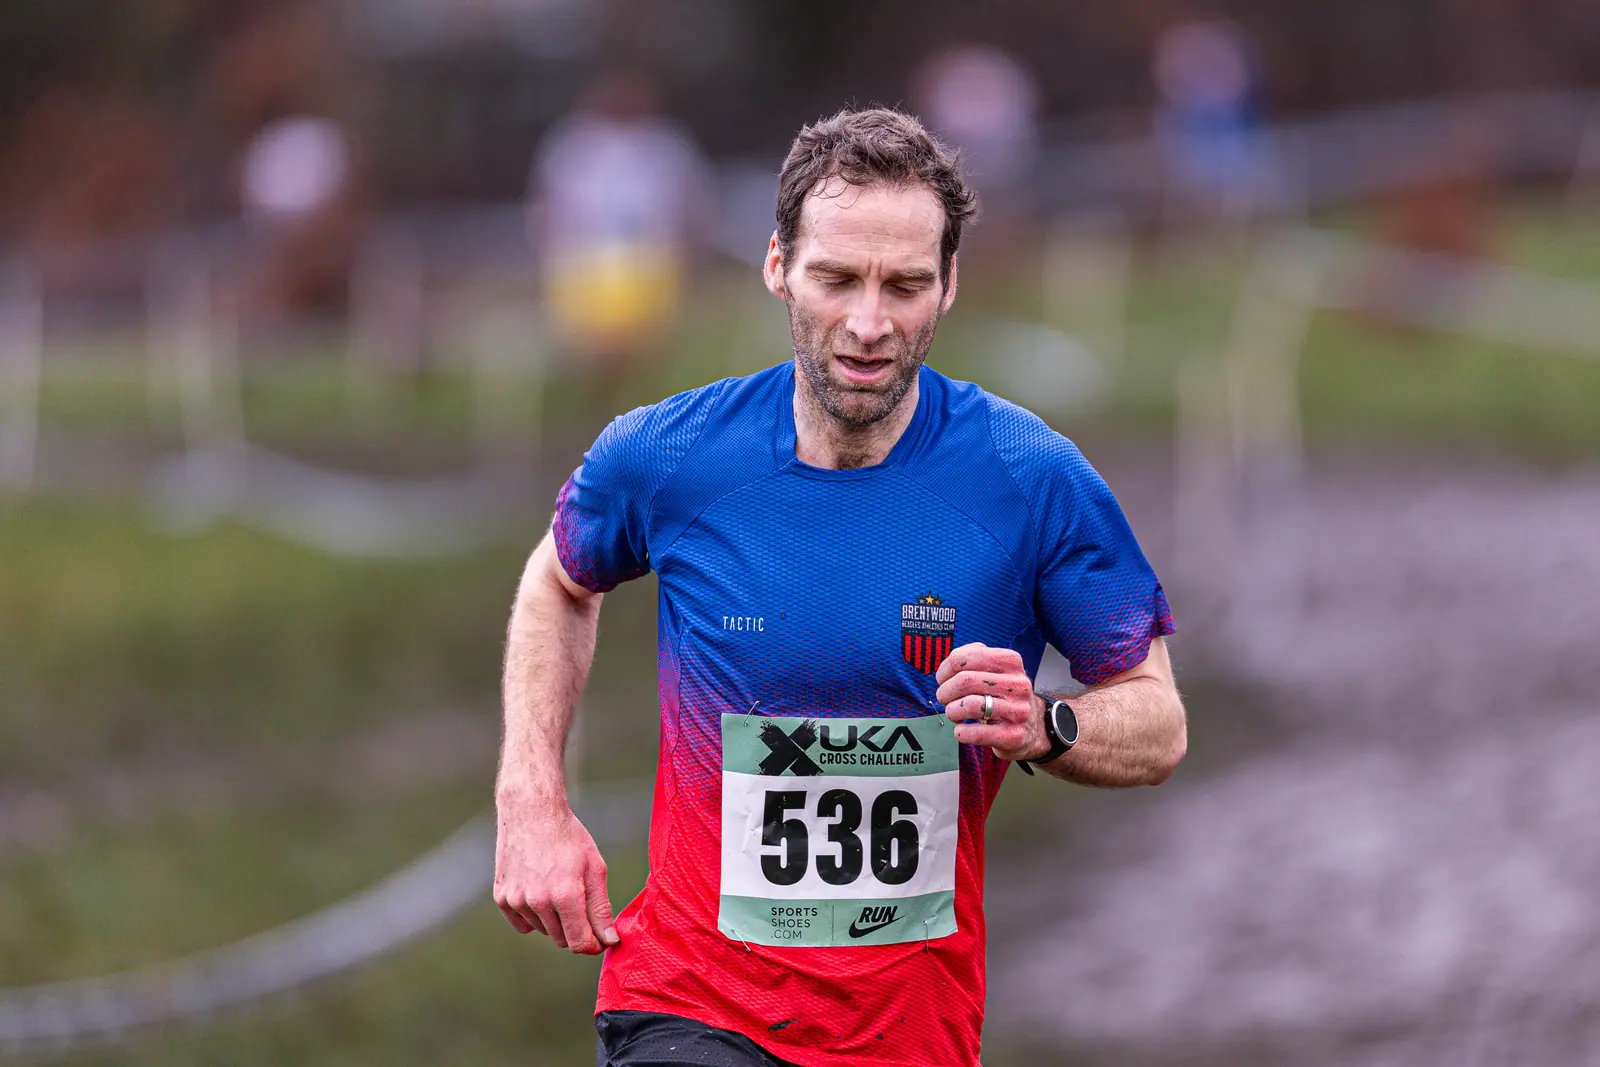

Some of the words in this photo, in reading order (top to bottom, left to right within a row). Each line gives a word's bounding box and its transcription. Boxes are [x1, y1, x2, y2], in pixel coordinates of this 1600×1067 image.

[902, 604, 956, 621] BRENTWOOD
[722, 615, 764, 632] TACTIC
[819, 725, 924, 753] UKA
[819, 752, 857, 766] CROSS
[860, 752, 925, 766] CHALLENGE
[760, 788, 920, 886] 536
[771, 906, 818, 917] SPORTS
[858, 905, 899, 924] RUN
[771, 917, 811, 928] SHOES
[770, 929, 802, 940] .COM
